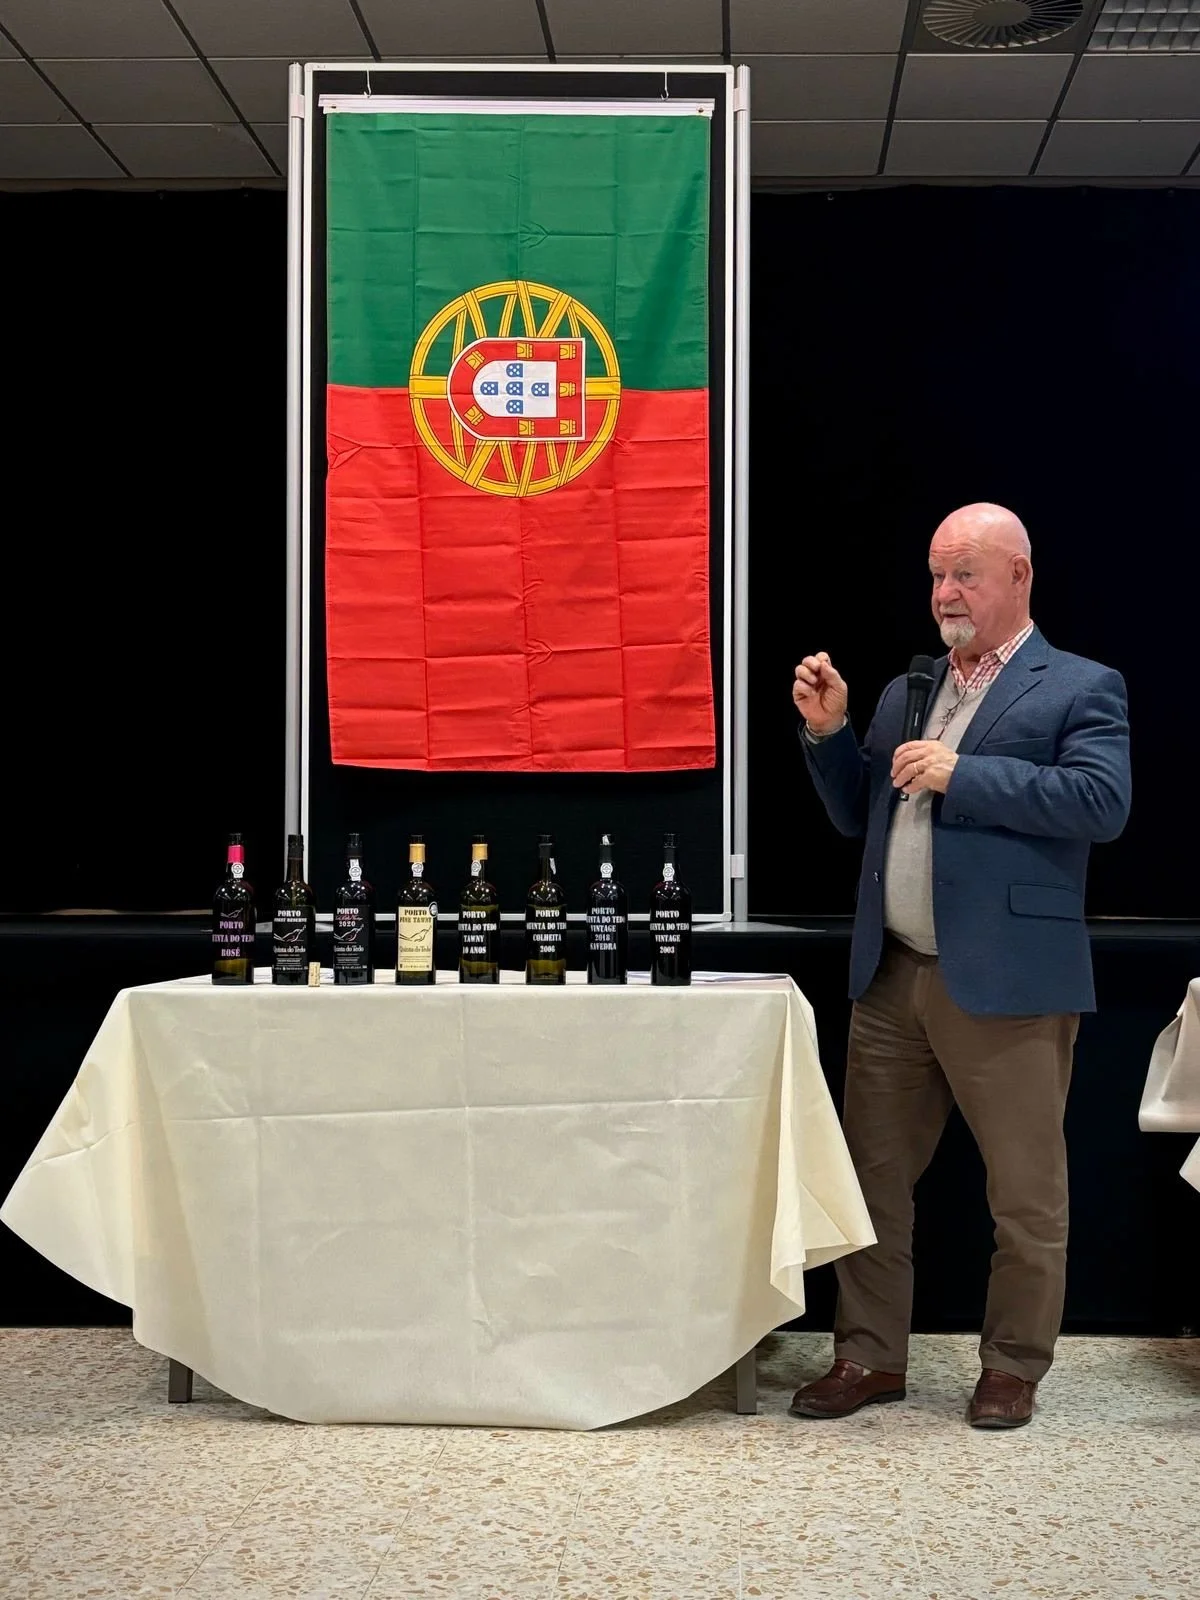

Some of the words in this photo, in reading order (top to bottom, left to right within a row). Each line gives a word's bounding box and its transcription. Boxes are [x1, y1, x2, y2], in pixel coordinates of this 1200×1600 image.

[535, 909, 560, 917] PORTO
[591, 907, 615, 915] PORTO
[655, 910, 680, 918] PORTO
[219, 921, 243, 930] PORTO
[472, 923, 482, 931] DO
[590, 924, 617, 933] VINTAGE
[666, 923, 675, 931] DO
[230, 934, 240, 943] DO
[464, 935, 484, 943] TAWNY
[532, 933, 562, 941] COLHEITA
[594, 933, 611, 941] 2018
[654, 934, 681, 942] VINTAGE
[221, 947, 240, 957] ROSÉ
[287, 945, 294, 953] do
[462, 946, 469, 954] 10
[469, 946, 487, 954] ANOS
